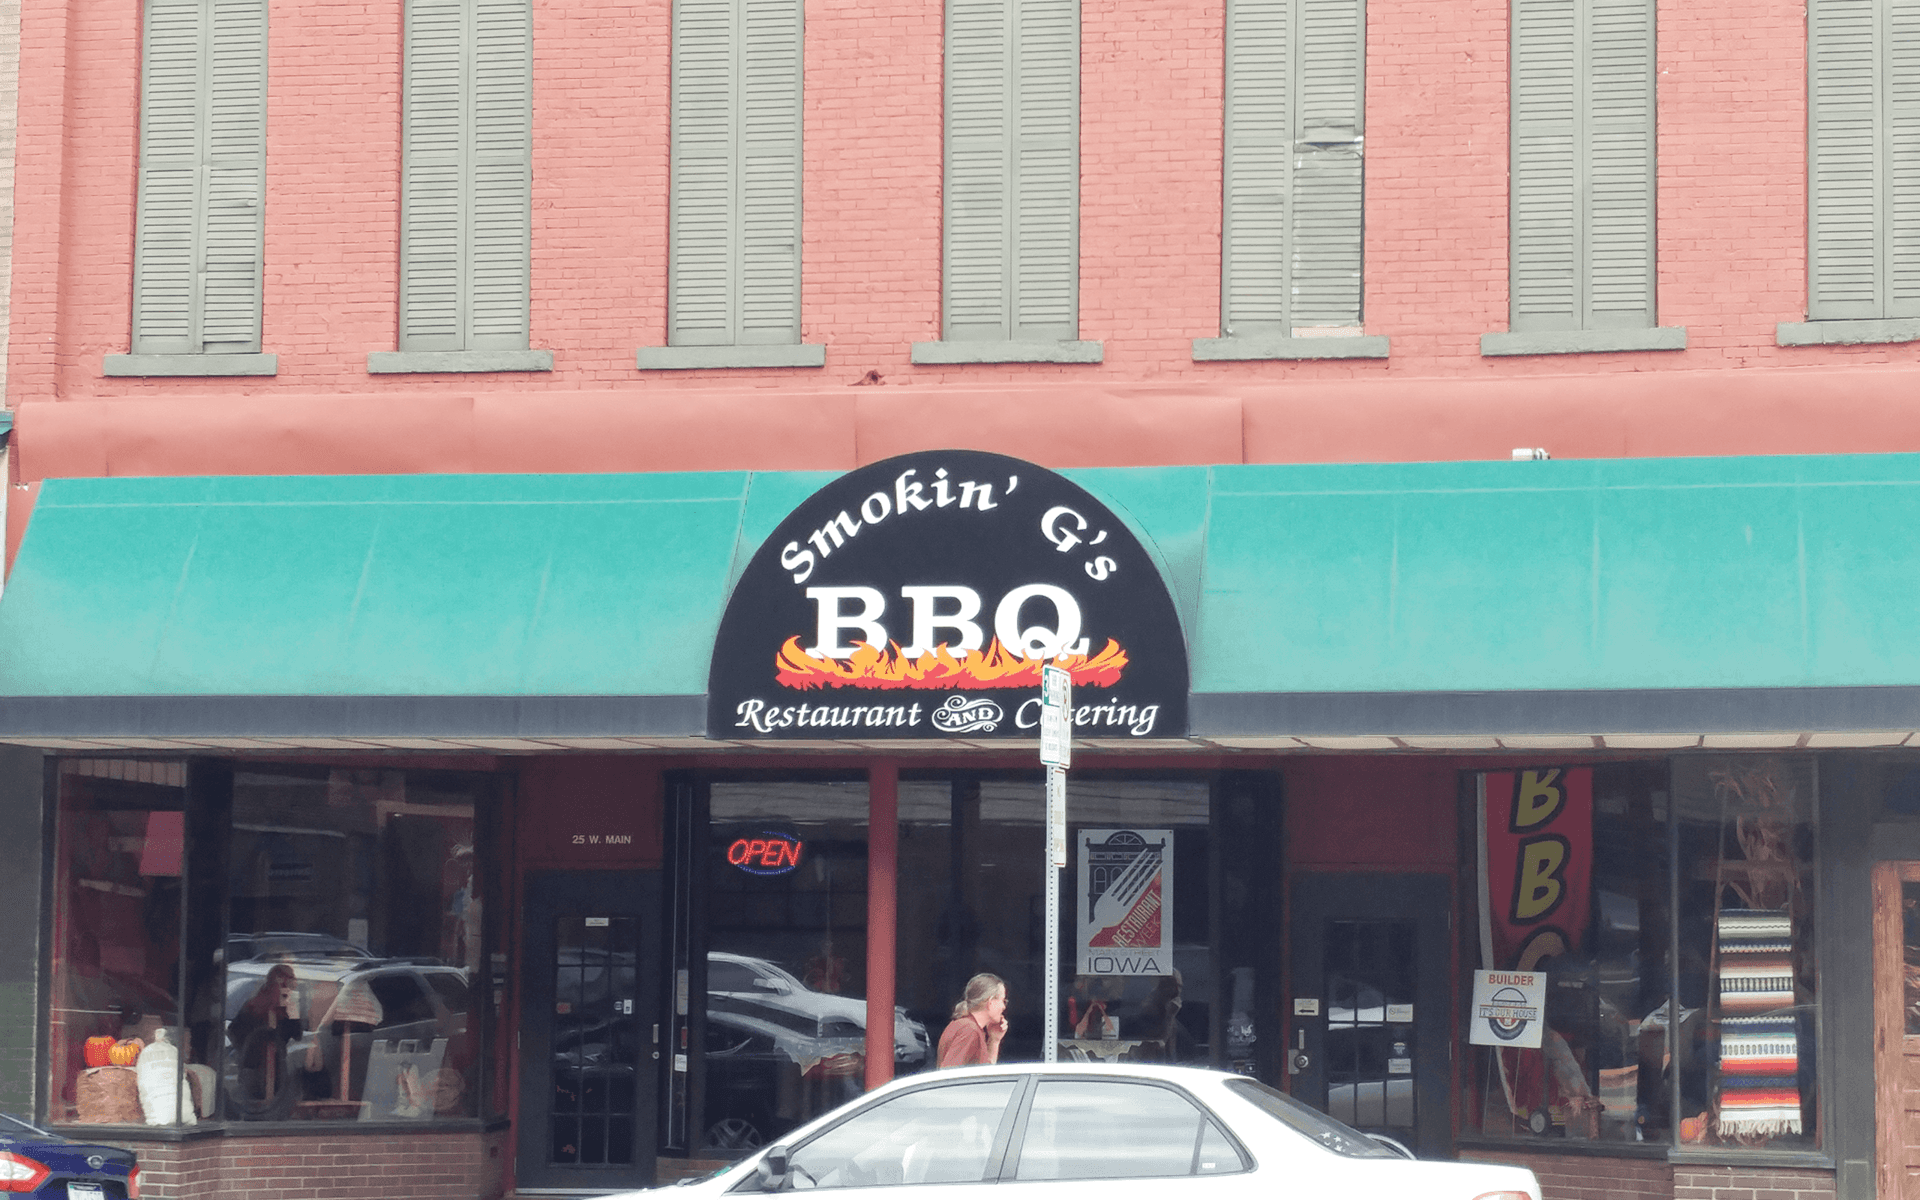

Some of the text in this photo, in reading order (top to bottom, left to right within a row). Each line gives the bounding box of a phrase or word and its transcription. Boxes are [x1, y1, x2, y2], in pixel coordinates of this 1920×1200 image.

[781, 467, 1117, 584] Smokin' G's
[805, 583, 1090, 661] BBQ
[735, 698, 922, 733] Restaurant
[946, 706, 994, 726] AND
[1015, 697, 1160, 736] Cering
[572, 834, 632, 844] 25 W. MAIN
[727, 838, 802, 866] OPEN
[1111, 888, 1162, 948] RESTAURANT
[1088, 957, 1161, 973] IOWA
[1488, 974, 1534, 986] BUILDER
[1512, 1009, 1537, 1018] HOUSE
